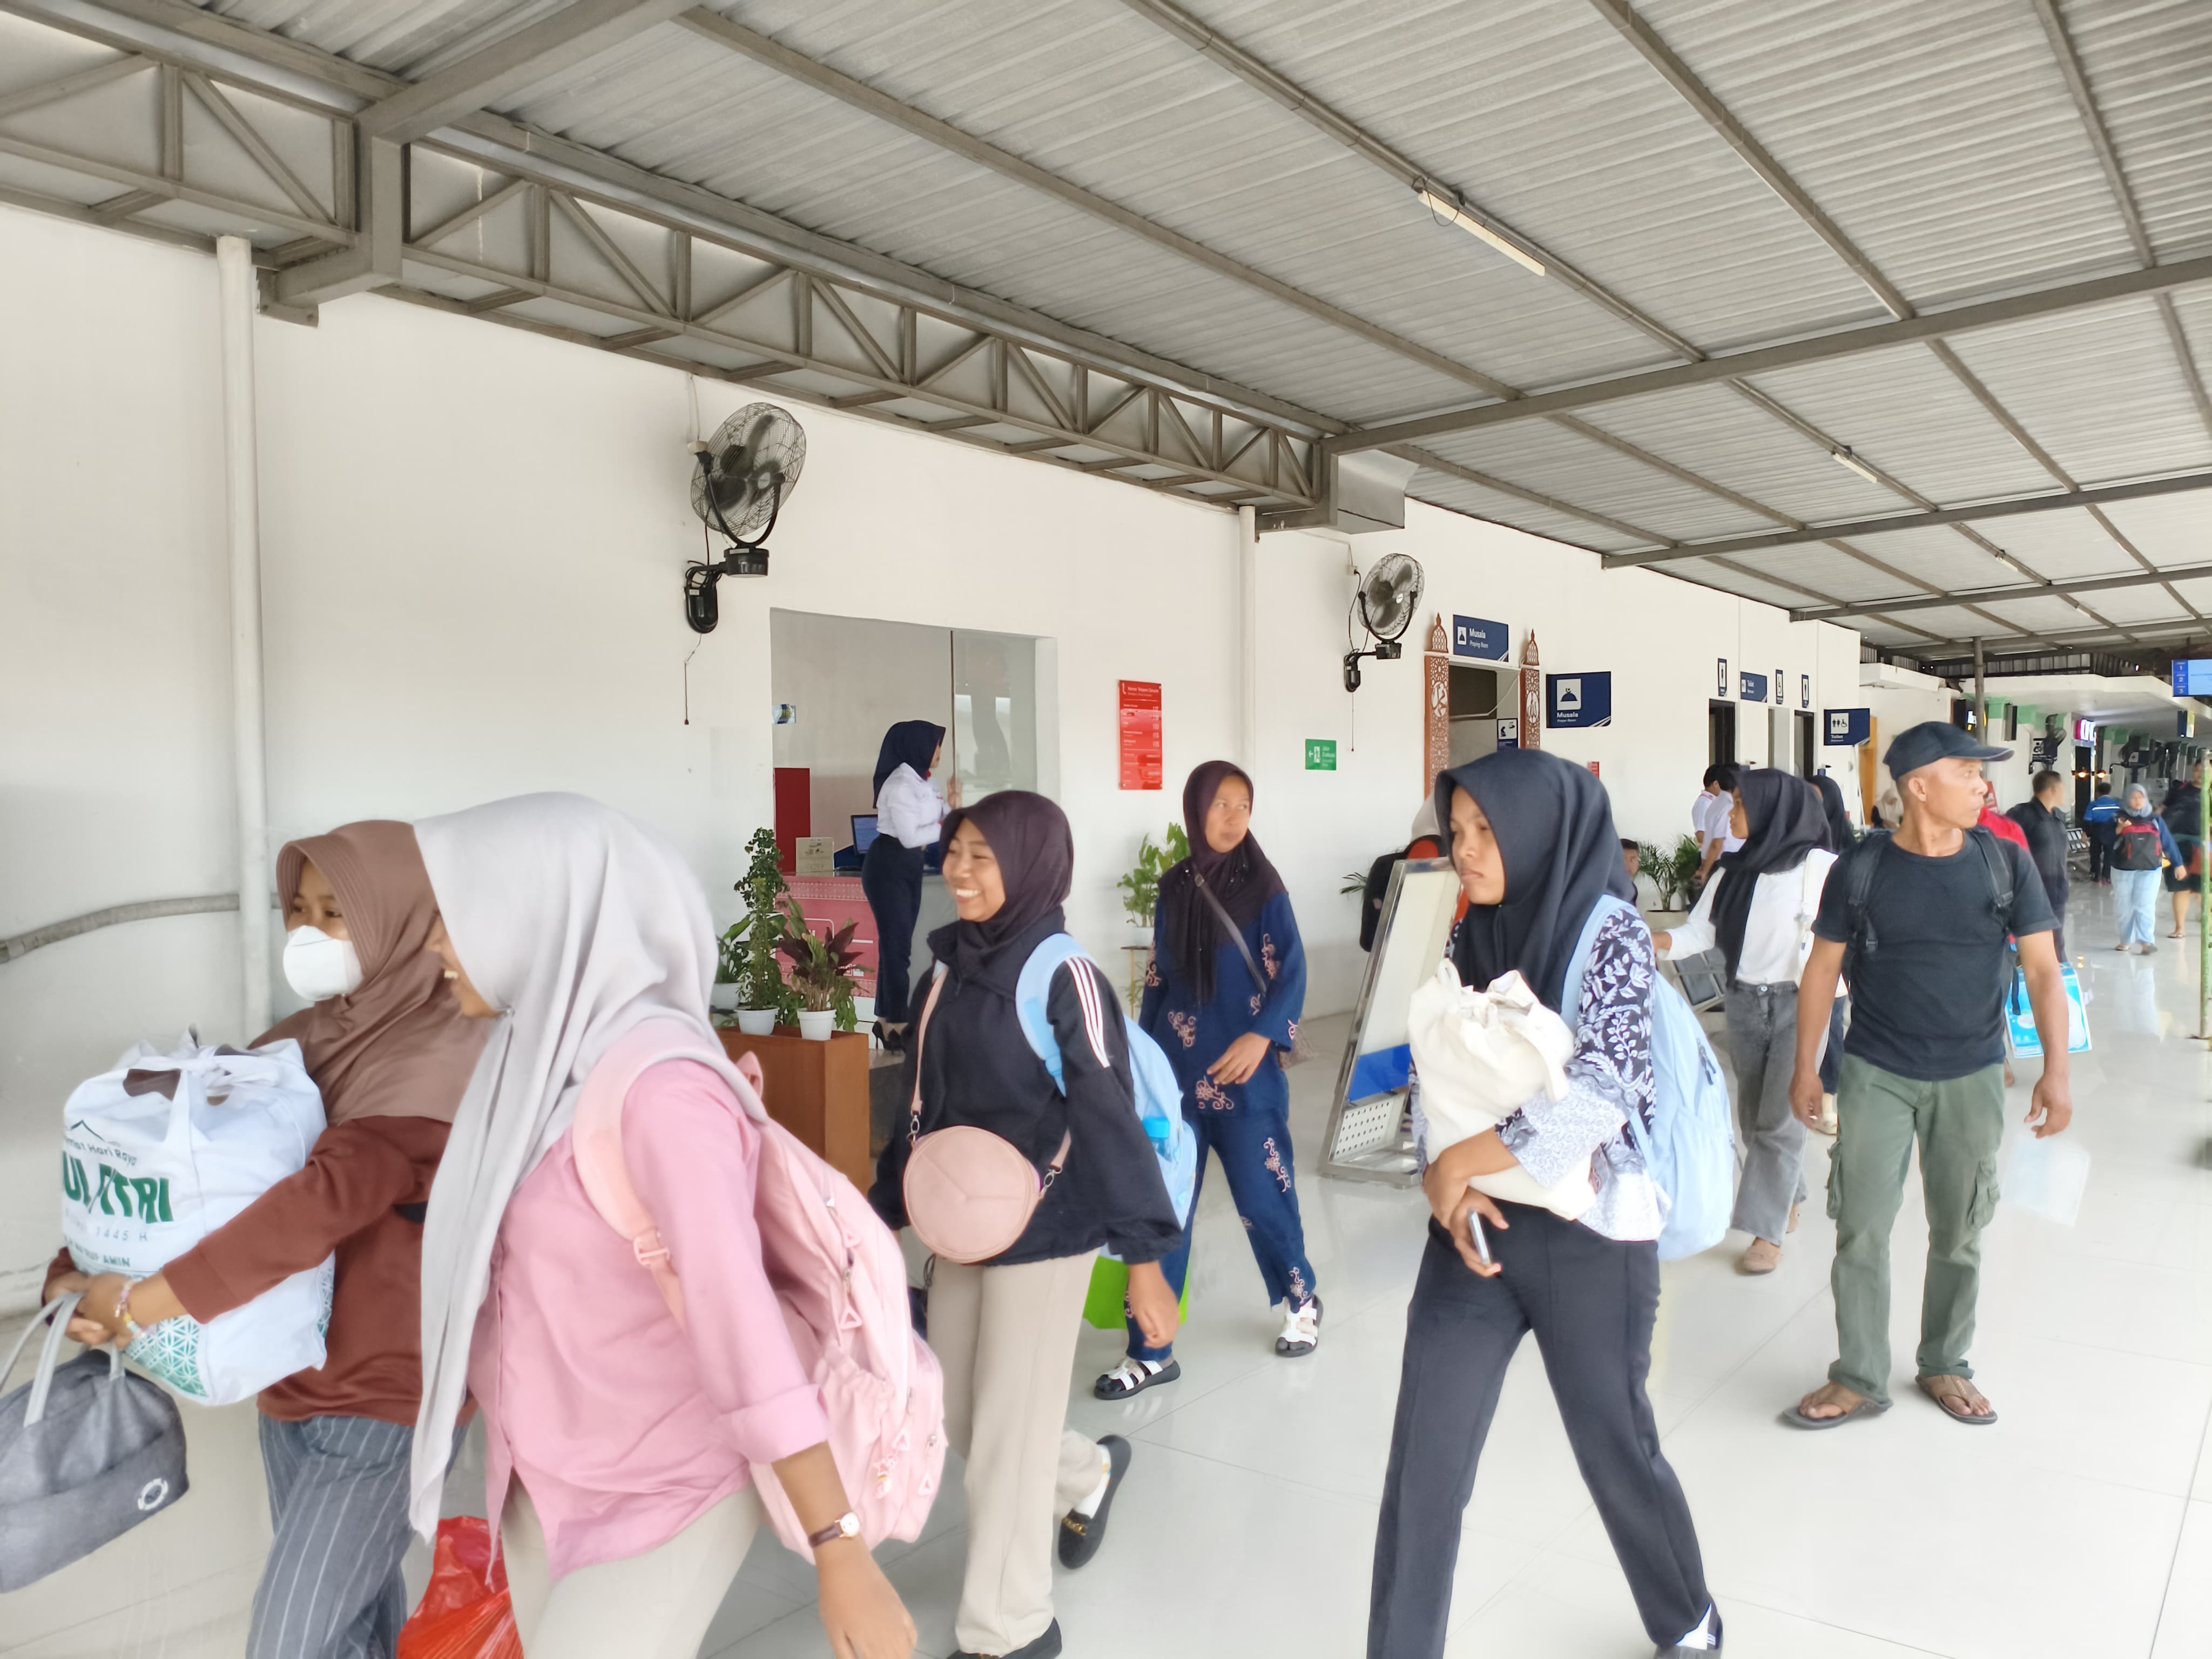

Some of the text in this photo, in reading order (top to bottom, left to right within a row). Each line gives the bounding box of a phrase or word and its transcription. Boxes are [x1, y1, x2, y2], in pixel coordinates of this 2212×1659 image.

[1469, 628, 1486, 639] Musala
[88, 1143, 113, 1157] Hari
[114, 1149, 138, 1166] Raya
[96, 1226, 147, 1242] 1445 H
[103, 1254, 130, 1267] AMIN
